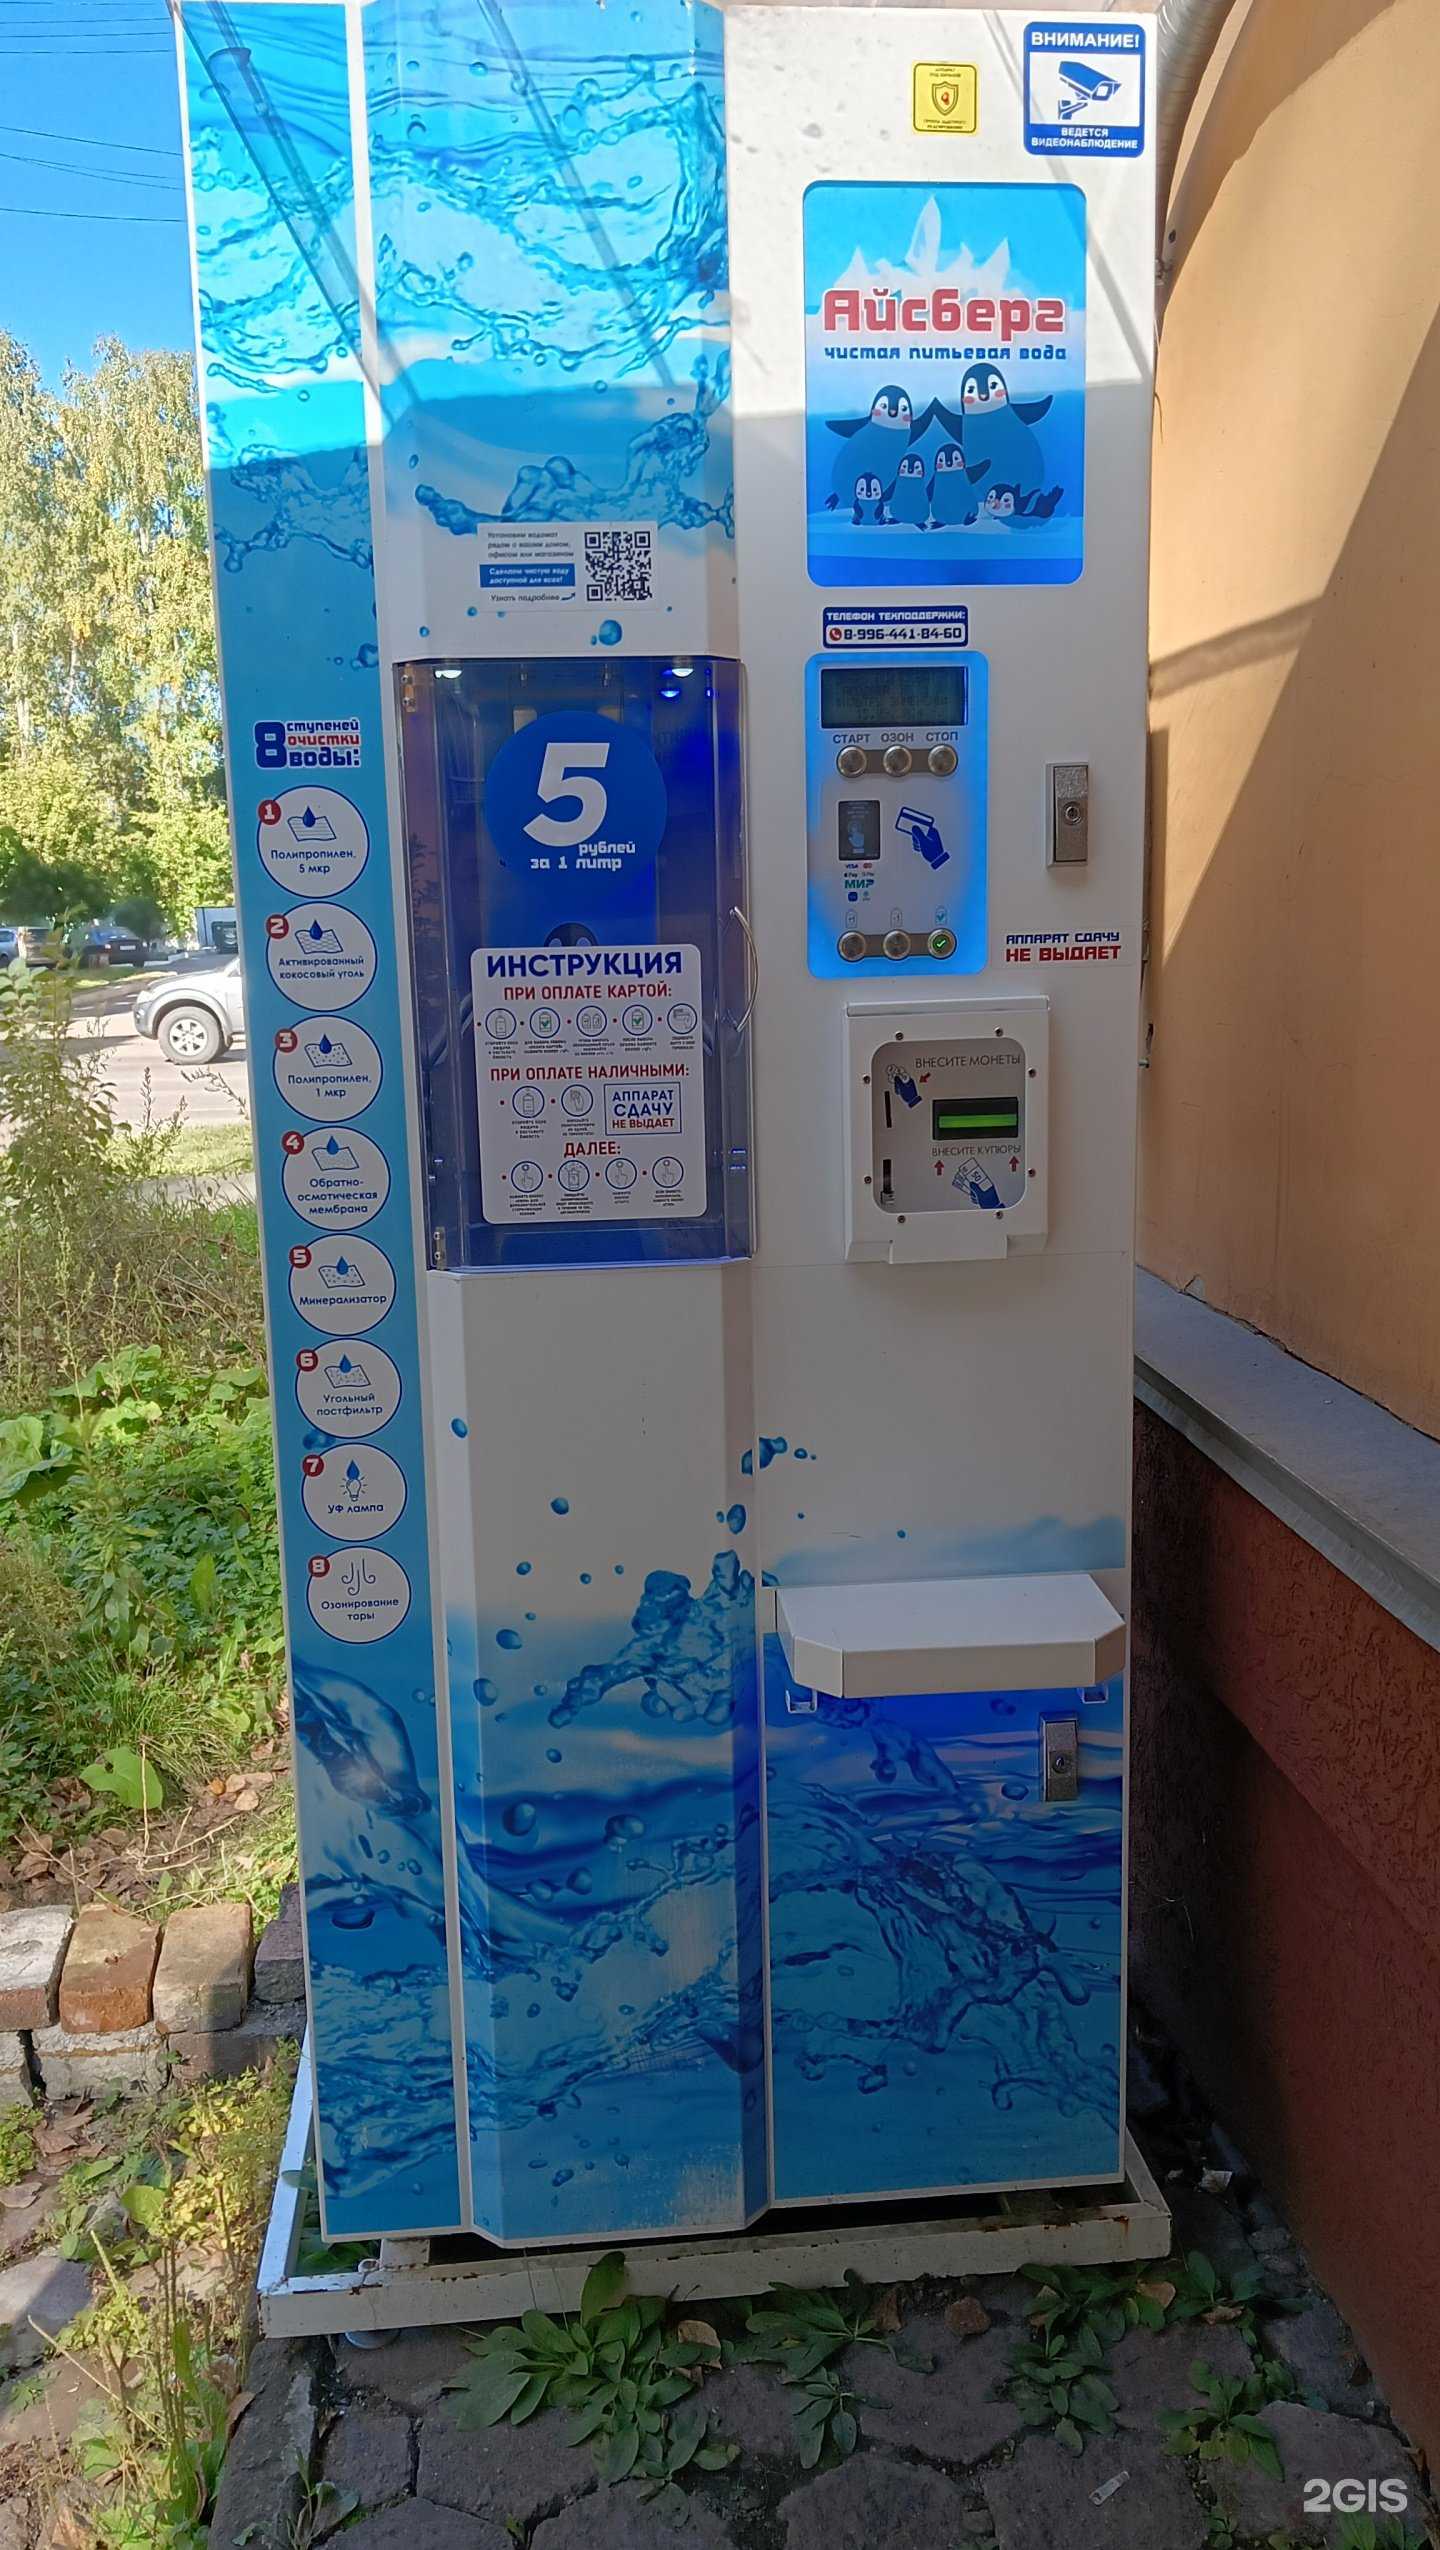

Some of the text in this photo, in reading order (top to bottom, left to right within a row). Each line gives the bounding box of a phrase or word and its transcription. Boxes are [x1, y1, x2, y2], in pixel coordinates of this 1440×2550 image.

[1031, 31, 1139, 48] ВНИМАНИЕ!
[1061, 127, 1108, 138] ВЕДЕТСЯ
[1031, 137, 1138, 149] ВИДЕОНАБЛЮДЕНИЕ
[824, 288, 1064, 341] Айсберг
[824, 344, 1067, 360] чистая питьевая вода
[826, 611, 965, 621] ТЕЛЕФОН ТЕХПОДДЕРЖКИ:
[844, 628, 962, 640] 8-996-441-84-60
[286, 719, 359, 733] ступеней
[288, 735, 359, 746] очистки
[833, 734, 870, 744] СТАРТ
[881, 732, 914, 742] ОЗОН
[926, 731, 958, 742] СТОП
[254, 722, 287, 768] 8
[289, 747, 360, 766] воды:
[522, 742, 610, 847] 5
[264, 804, 276, 820] 1
[578, 841, 636, 856] рублей
[299, 864, 331, 875] 5 мкр
[530, 856, 622, 872] за 1 литр
[844, 879, 875, 889] МИР
[270, 918, 284, 934] 2
[1006, 931, 1120, 944] АППАРАТ СДАЧУ
[1006, 945, 1121, 962] НЕ ВЫДАЕТ
[278, 956, 364, 967] Активированный
[487, 951, 682, 978] ИНСТРУКЦИЯ
[279, 968, 365, 979] кокосовый уголь
[504, 980, 672, 1000] ПРИ ОПЛАТЕ КАРТОЙ:
[280, 1032, 293, 1047] 3
[915, 1055, 1020, 1068] ВНЕСИТЕ МОНЕТЫ
[490, 1064, 689, 1081] ПРИ ОПЛАТЕ НАЛИЧНЫМИ:
[316, 1088, 346, 1099] 1 мкр
[612, 1090, 674, 1101] АППАРАТ
[613, 1102, 673, 1118] СДАЧУ
[612, 1117, 675, 1129] НЕ ВЫДАЕТ
[286, 1134, 300, 1150] 4
[563, 1141, 621, 1157] ДАЛЕЕ:
[931, 1147, 975, 1157] ВНЕСИТЕ
[309, 1178, 364, 1189] Обратно-
[297, 1191, 378, 1201] осмотическая
[309, 1204, 368, 1215] мембрана
[293, 1250, 306, 1264] 5
[299, 1295, 387, 1306] Минерализатор
[300, 1354, 314, 1367] 6
[323, 1392, 375, 1404] Угольный
[316, 1405, 383, 1417] постфильтр
[306, 1459, 319, 1473] 7
[327, 1503, 384, 1514] УФ лампа
[312, 1560, 325, 1573] 8
[321, 1598, 399, 1611] Озонирование
[347, 1612, 375, 1622] тары
